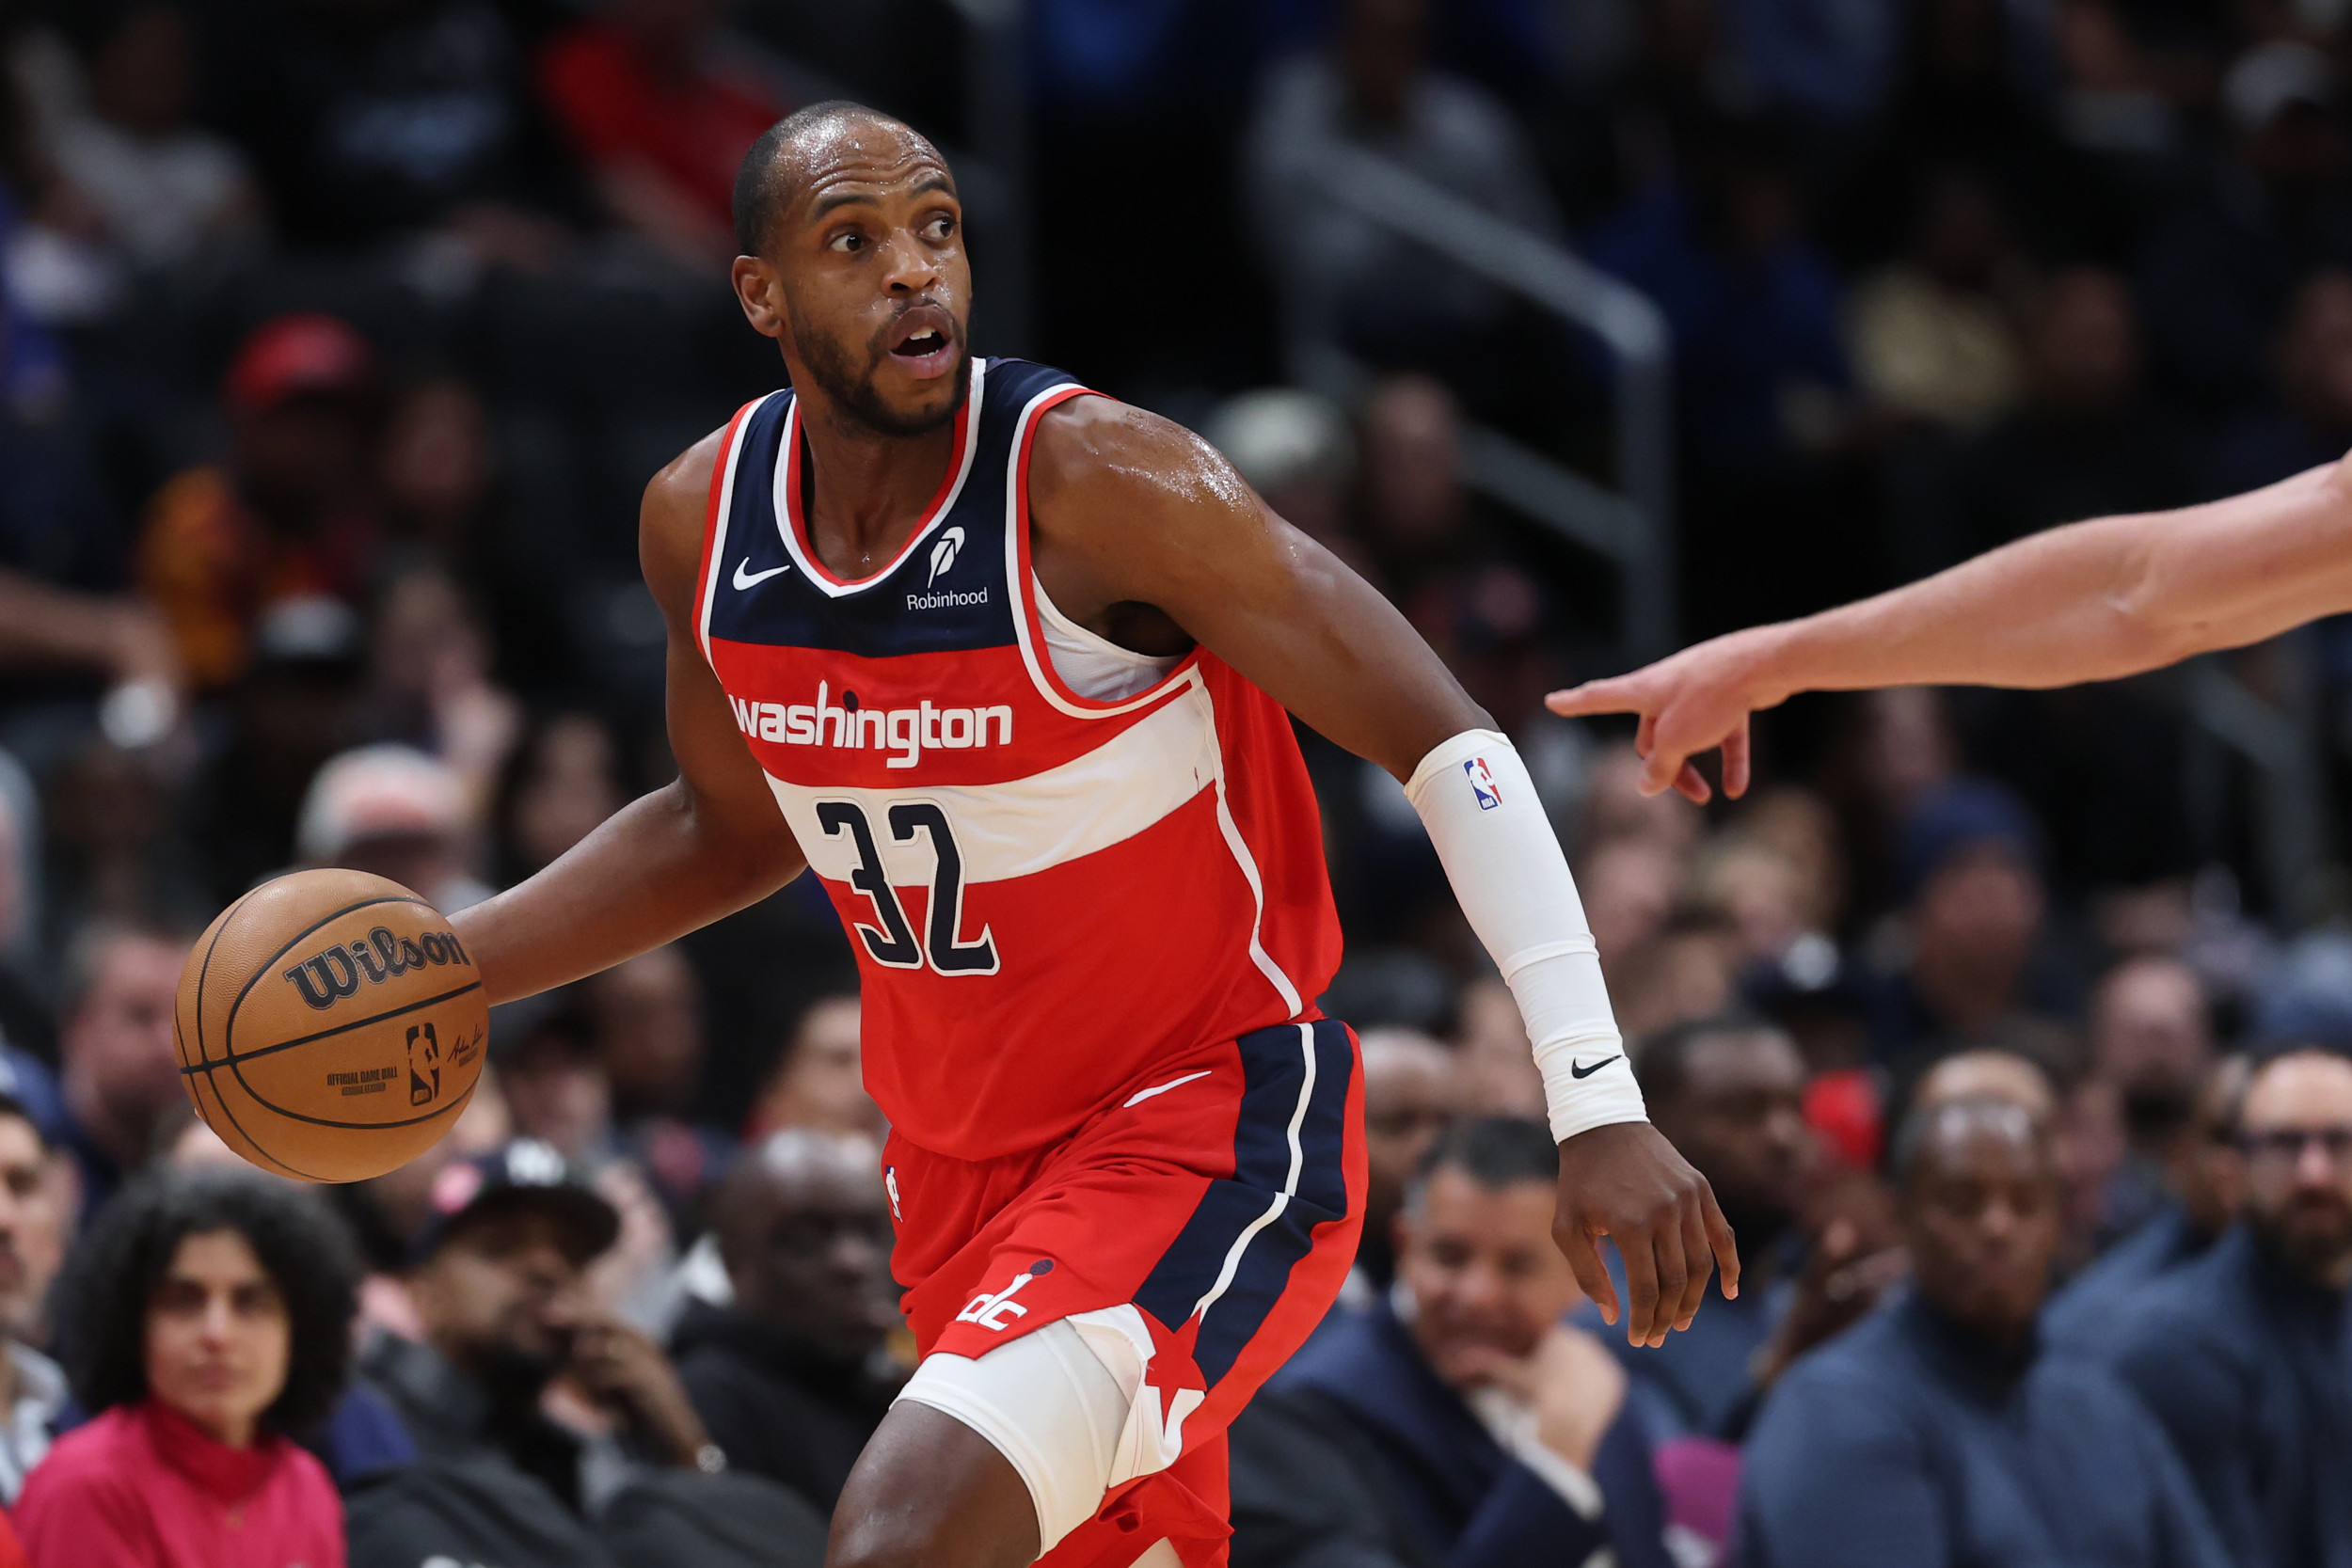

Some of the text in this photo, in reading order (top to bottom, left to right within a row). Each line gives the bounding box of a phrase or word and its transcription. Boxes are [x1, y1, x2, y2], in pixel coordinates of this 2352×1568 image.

[906, 587, 988, 610] Robinhood
[727, 679, 1012, 768] washington
[815, 798, 1000, 976] 32
[283, 927, 470, 1010] Wilson
